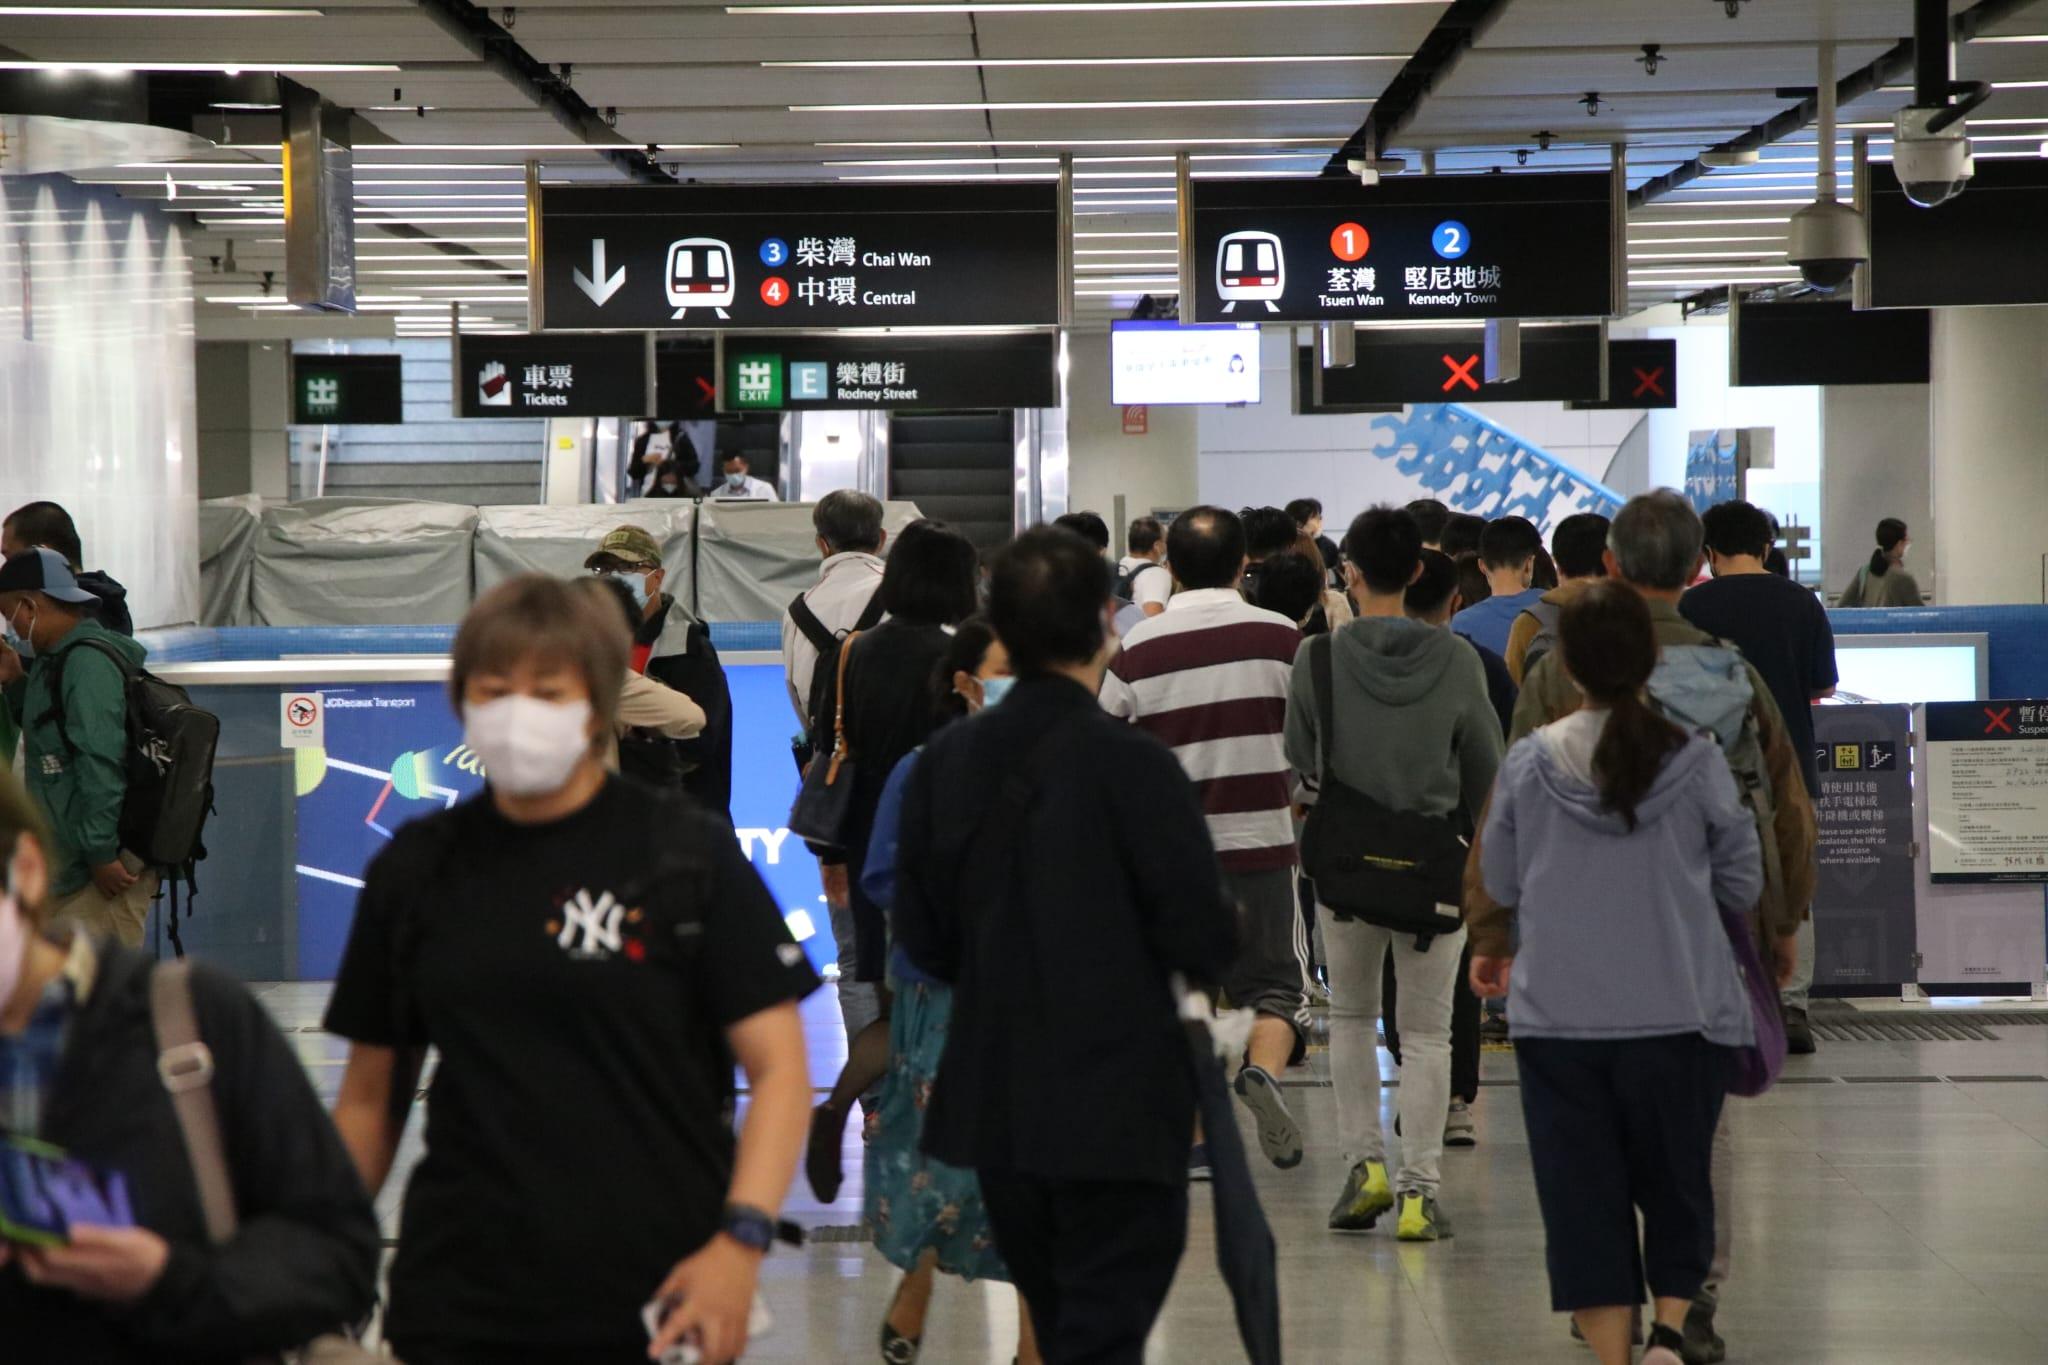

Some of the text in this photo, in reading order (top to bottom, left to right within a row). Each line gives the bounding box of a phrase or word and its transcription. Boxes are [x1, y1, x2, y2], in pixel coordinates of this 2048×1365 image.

[796, 237, 857, 267] 柴灣
[862, 252, 895, 267] Chai
[898, 252, 931, 267] Wan
[1342, 230, 1354, 255] 1
[1443, 228, 1461, 253] 2
[1327, 267, 1376, 292] 荃灣
[1404, 265, 1501, 290] 堅尼地城
[797, 276, 857, 306] 中環
[863, 291, 916, 305] Central
[1319, 294, 1384, 306] Tsuen Wan
[1408, 292, 1497, 307] Kennedy Town
[522, 364, 574, 390] 車票
[802, 368, 817, 393] E
[836, 362, 906, 385] 樂禮街
[523, 392, 568, 406] Tickets
[739, 390, 770, 401] EXIT
[837, 387, 918, 401] Rodney Street
[1855, 826, 1887, 835] another
[1820, 855, 1881, 865] where available
[1836, 847, 1871, 855] staircase
